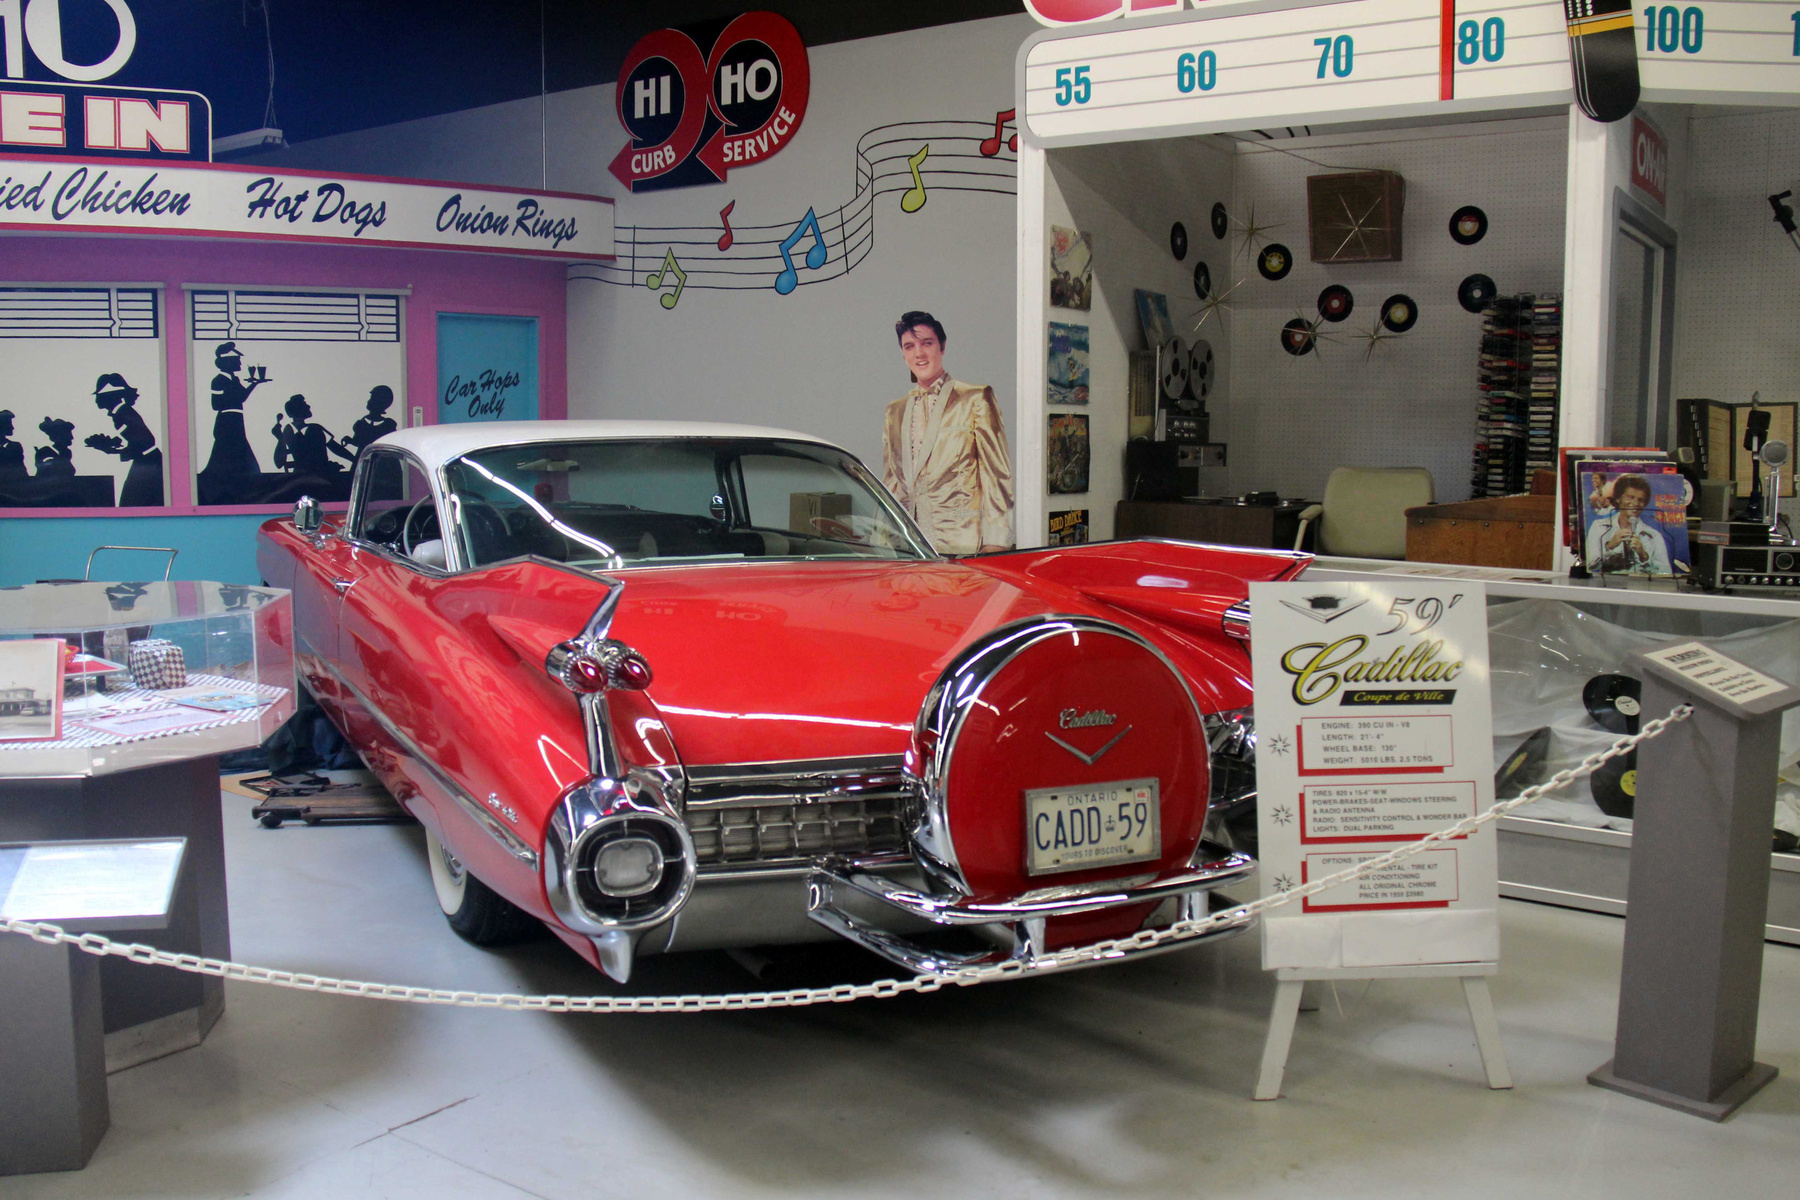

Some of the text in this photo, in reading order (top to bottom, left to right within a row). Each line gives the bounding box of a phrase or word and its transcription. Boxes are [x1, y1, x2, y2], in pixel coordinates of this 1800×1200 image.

[1055, 66, 1091, 106] 55
[1177, 50, 1216, 93] 60
[1313, 35, 1354, 79] 70
[1457, 17, 1505, 65] 80
[1644, 5, 1704, 54] 100
[634, 75, 671, 119] HI
[721, 58, 778, 105] HO
[84, 95, 190, 153] IN
[722, 106, 796, 162] SERVICE
[631, 144, 676, 174] CURB
[52, 166, 191, 221] Chicken
[246, 176, 387, 237] Hot Dogs
[436, 193, 578, 249] Onion Rings
[445, 369, 520, 405] Car Hops
[468, 391, 505, 419] Only
[1280, 634, 1464, 706] Cadillac
[1353, 689, 1445, 704] Coupe de Ville
[1059, 707, 1117, 729] Cadillac
[1321, 722, 1354, 730] ENGINE:
[1358, 721, 1371, 729] 390
[1353, 744, 1376, 752] BASE:
[1067, 791, 1118, 806] ONTARIO
[1035, 802, 1148, 851] CADD 59
[1340, 815, 1380, 823] SENSITIVITY
[1382, 814, 1414, 822] CONTROL
[1422, 813, 1451, 821] WONDER
[1085, 849, 1093, 859] TO
[1095, 845, 1128, 857] DISCOVER
[1374, 882, 1405, 890] ORIGINAL
